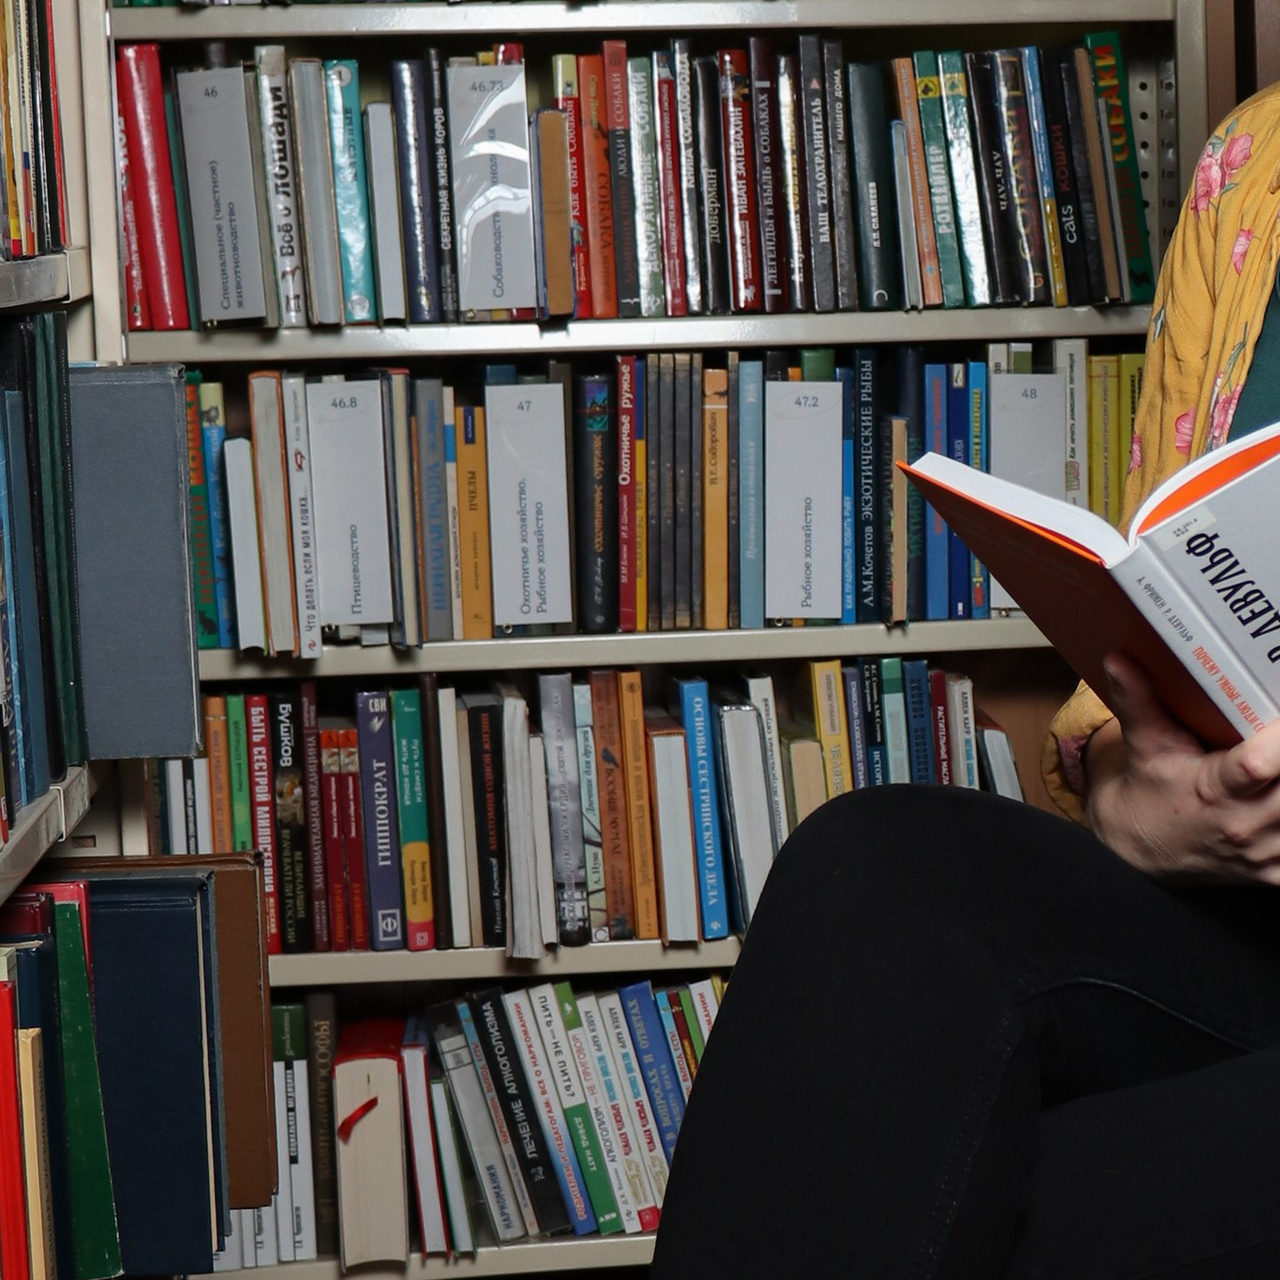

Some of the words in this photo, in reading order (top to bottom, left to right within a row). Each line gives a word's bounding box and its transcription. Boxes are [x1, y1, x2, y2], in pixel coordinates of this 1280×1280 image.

[203, 87, 218, 98] 46
[612, 73, 624, 121] СОБАКИ
[615, 139, 627, 177] ЛЮДИ
[616, 125, 625, 134] И
[1051, 125, 1070, 191] КОШКИ
[208, 160, 223, 221] (частное)
[928, 146, 952, 233] РОТВЕЙЛЕР
[1061, 205, 1077, 243] cats
[214, 224, 231, 310] Специальное
[226, 202, 244, 308] животноводство
[330, 397, 359, 410] 46.8
[1021, 386, 1038, 398] 48
[534, 502, 546, 565] хозяйство
[349, 523, 364, 616] Птицеводство
[536, 567, 548, 614] Рыбное
[1143, 583, 1166, 610] ФРИМЕН
[1168, 615, 1193, 642] ДЕВУЛЬФ
[1192, 645, 1221, 677] ПОЧЕМУ
[1217, 674, 1243, 706] УМНЫЕ
[1237, 702, 1259, 728] ЛЮДИ
[251, 707, 267, 741] БЫТЬ
[693, 698, 707, 758] ОСНОВЫ
[252, 747, 271, 802] СЕСТРОЙ
[307, 736, 319, 797] МЕДИЦИНА
[373, 759, 391, 866] ГИППОКРАТ
[698, 760, 714, 867] СЕСТРИНСКОГО
[310, 800, 323, 889] ЗАНИМАТЕЛЬНАЯ
[705, 870, 718, 905] ДЕЛА
[538, 995, 553, 1026] ПИТЬ
[481, 1001, 519, 1095] АЛКОГОЛИЗМА
[552, 1041, 564, 1057] НЕ
[556, 1061, 575, 1098] ПИТЬ?
[511, 1099, 538, 1159] ЛЕЧЕНИЕ
[574, 1117, 589, 1147] ДЭВИД
[585, 1150, 596, 1171] НАТТ
[593, 1106, 617, 1163] АЛКОГОЛИЗМ
[486, 1164, 513, 1230] НАРКОМАНИЯ
